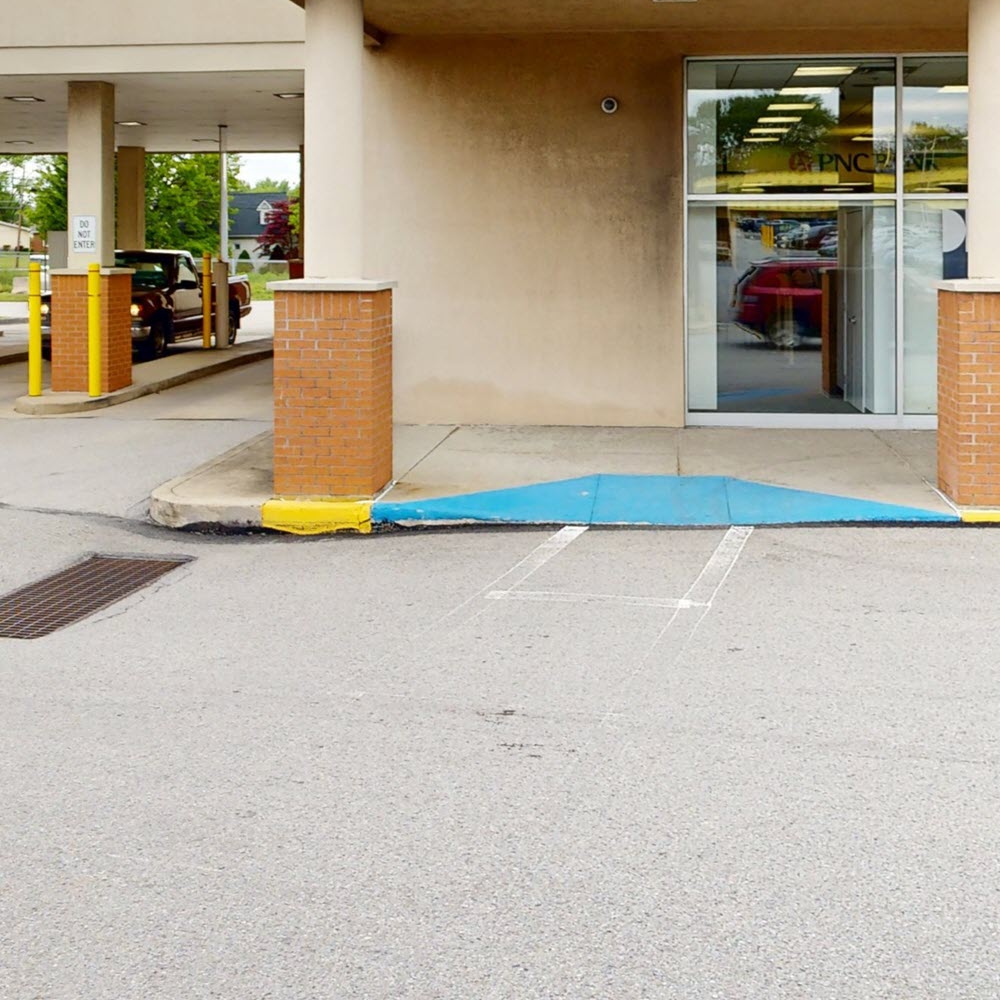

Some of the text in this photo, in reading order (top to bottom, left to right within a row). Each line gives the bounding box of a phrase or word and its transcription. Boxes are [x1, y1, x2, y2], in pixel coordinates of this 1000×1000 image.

[818, 152, 872, 172] PNC
[79, 220, 90, 229] DO
[77, 230, 91, 239] NOT
[73, 240, 96, 249] ENTER
